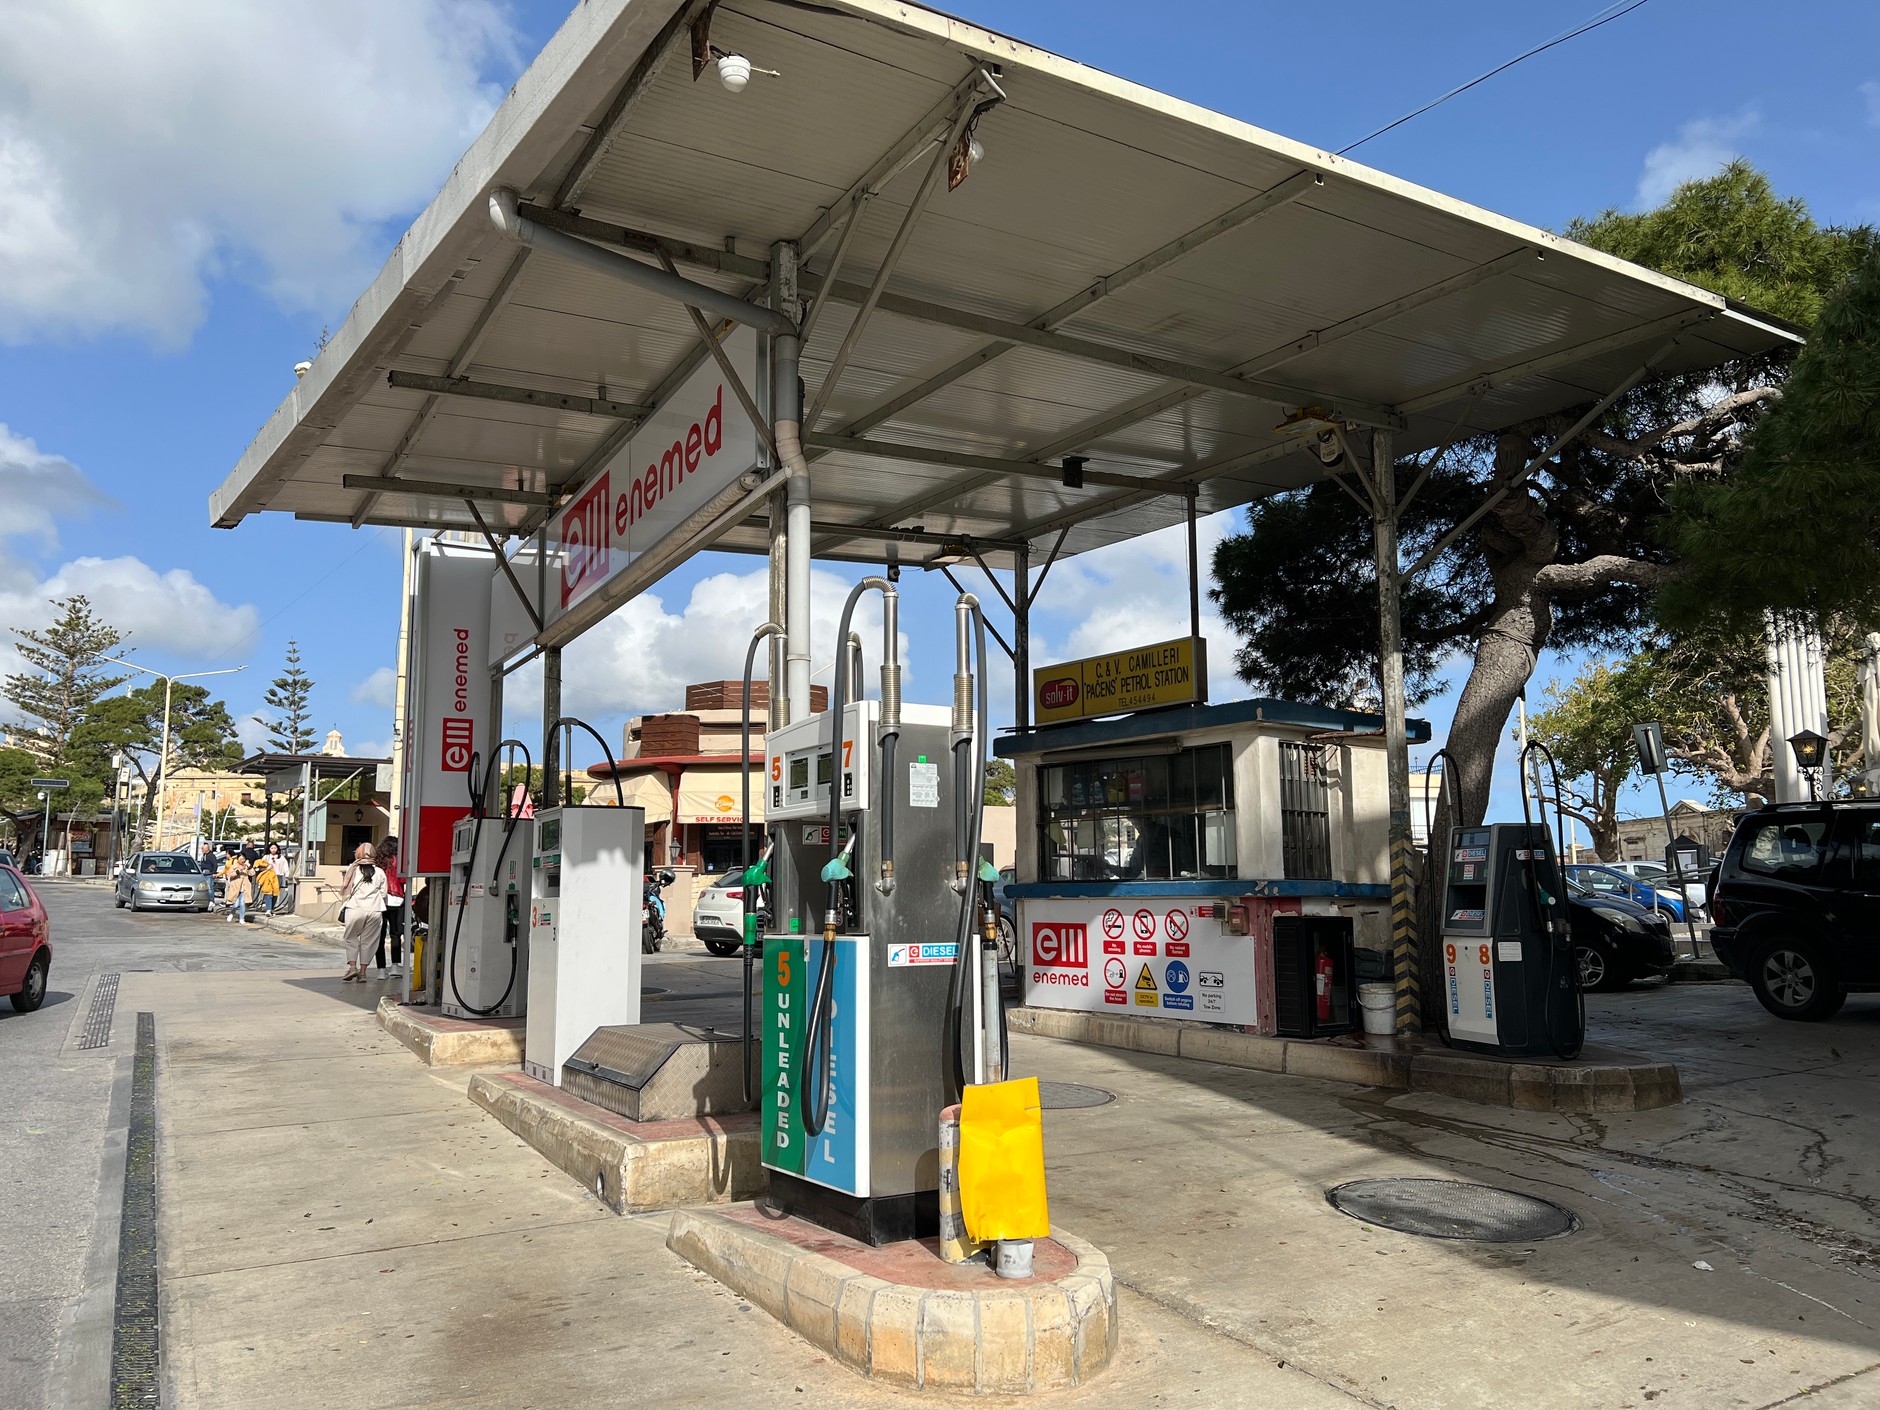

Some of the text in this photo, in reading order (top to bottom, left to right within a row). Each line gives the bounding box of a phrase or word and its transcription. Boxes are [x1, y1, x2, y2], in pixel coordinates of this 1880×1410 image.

[615, 383, 722, 537] enemed
[454, 628, 470, 713] enemed
[1105, 660, 1111, 677] &
[1128, 646, 1179, 672] CAMILLERI
[1120, 674, 1152, 694] PETROL
[1154, 665, 1189, 688] STATION
[1045, 684, 1073, 705] solv-it
[843, 740, 853, 768] 7
[771, 756, 781, 782] 5
[532, 906, 538, 928] 3
[922, 946, 958, 957] DIESEL
[1446, 943, 1457, 964] 9
[1479, 943, 1490, 965] 8
[777, 951, 791, 987] 5
[1033, 971, 1089, 987] enemed
[1450, 977, 1459, 1014] DIESEL
[777, 993, 790, 1148] UNLEADED
